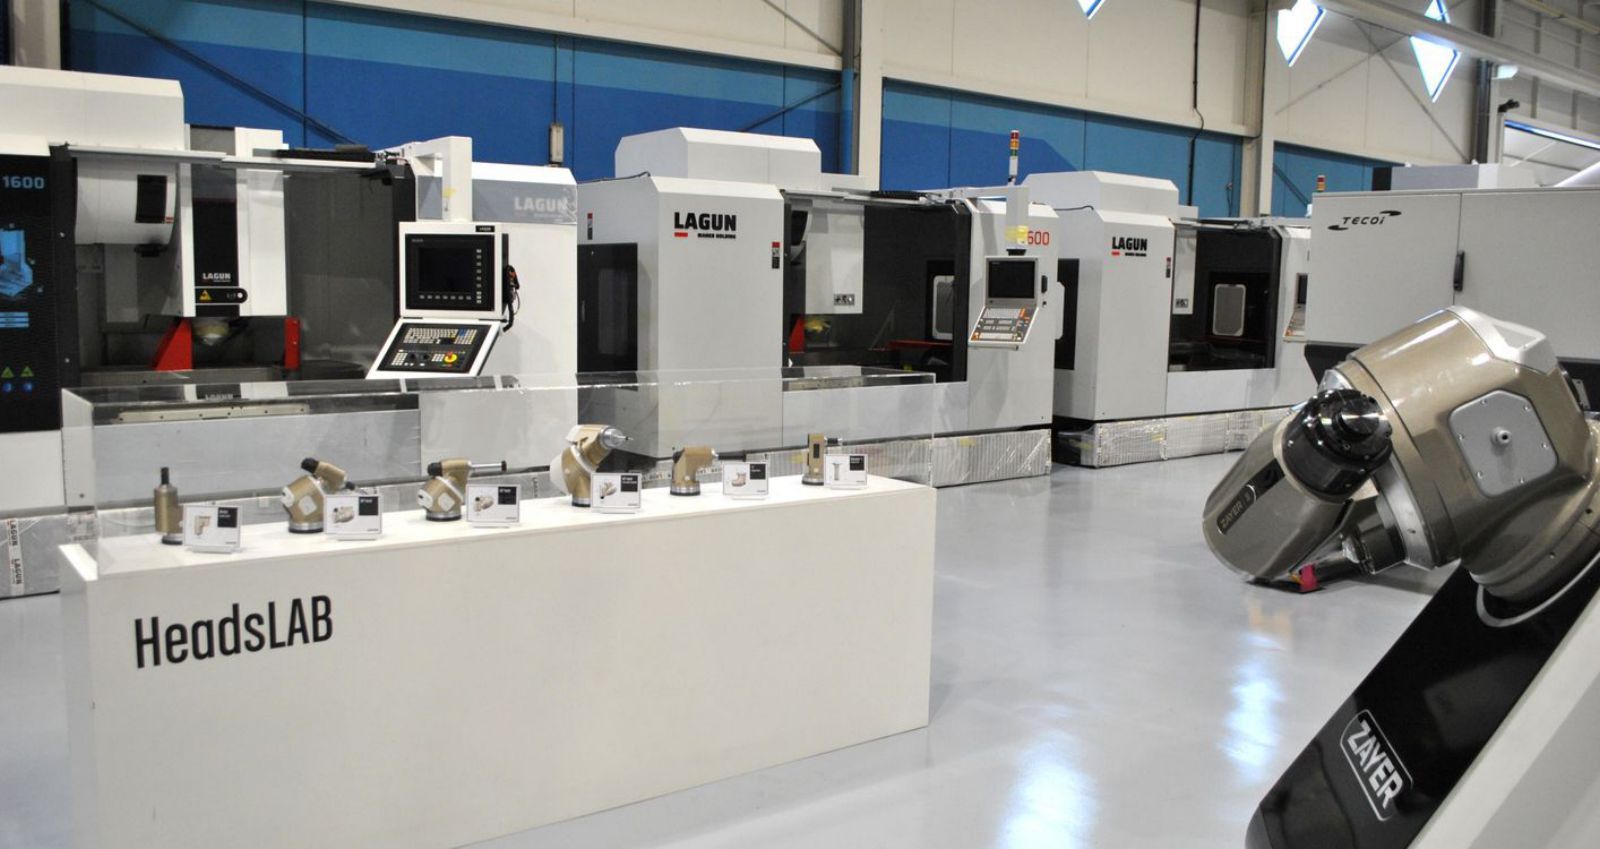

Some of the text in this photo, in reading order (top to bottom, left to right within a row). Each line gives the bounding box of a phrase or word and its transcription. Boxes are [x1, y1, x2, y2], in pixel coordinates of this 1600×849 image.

[2, 176, 45, 189] 1600
[514, 196, 569, 213] LAGUN
[674, 211, 737, 231] LAGUN
[1112, 236, 1148, 251] LAGUN
[202, 272, 231, 280] LAGUN
[135, 595, 333, 669] HeadsLAB
[1347, 719, 1404, 810] ZAYER
